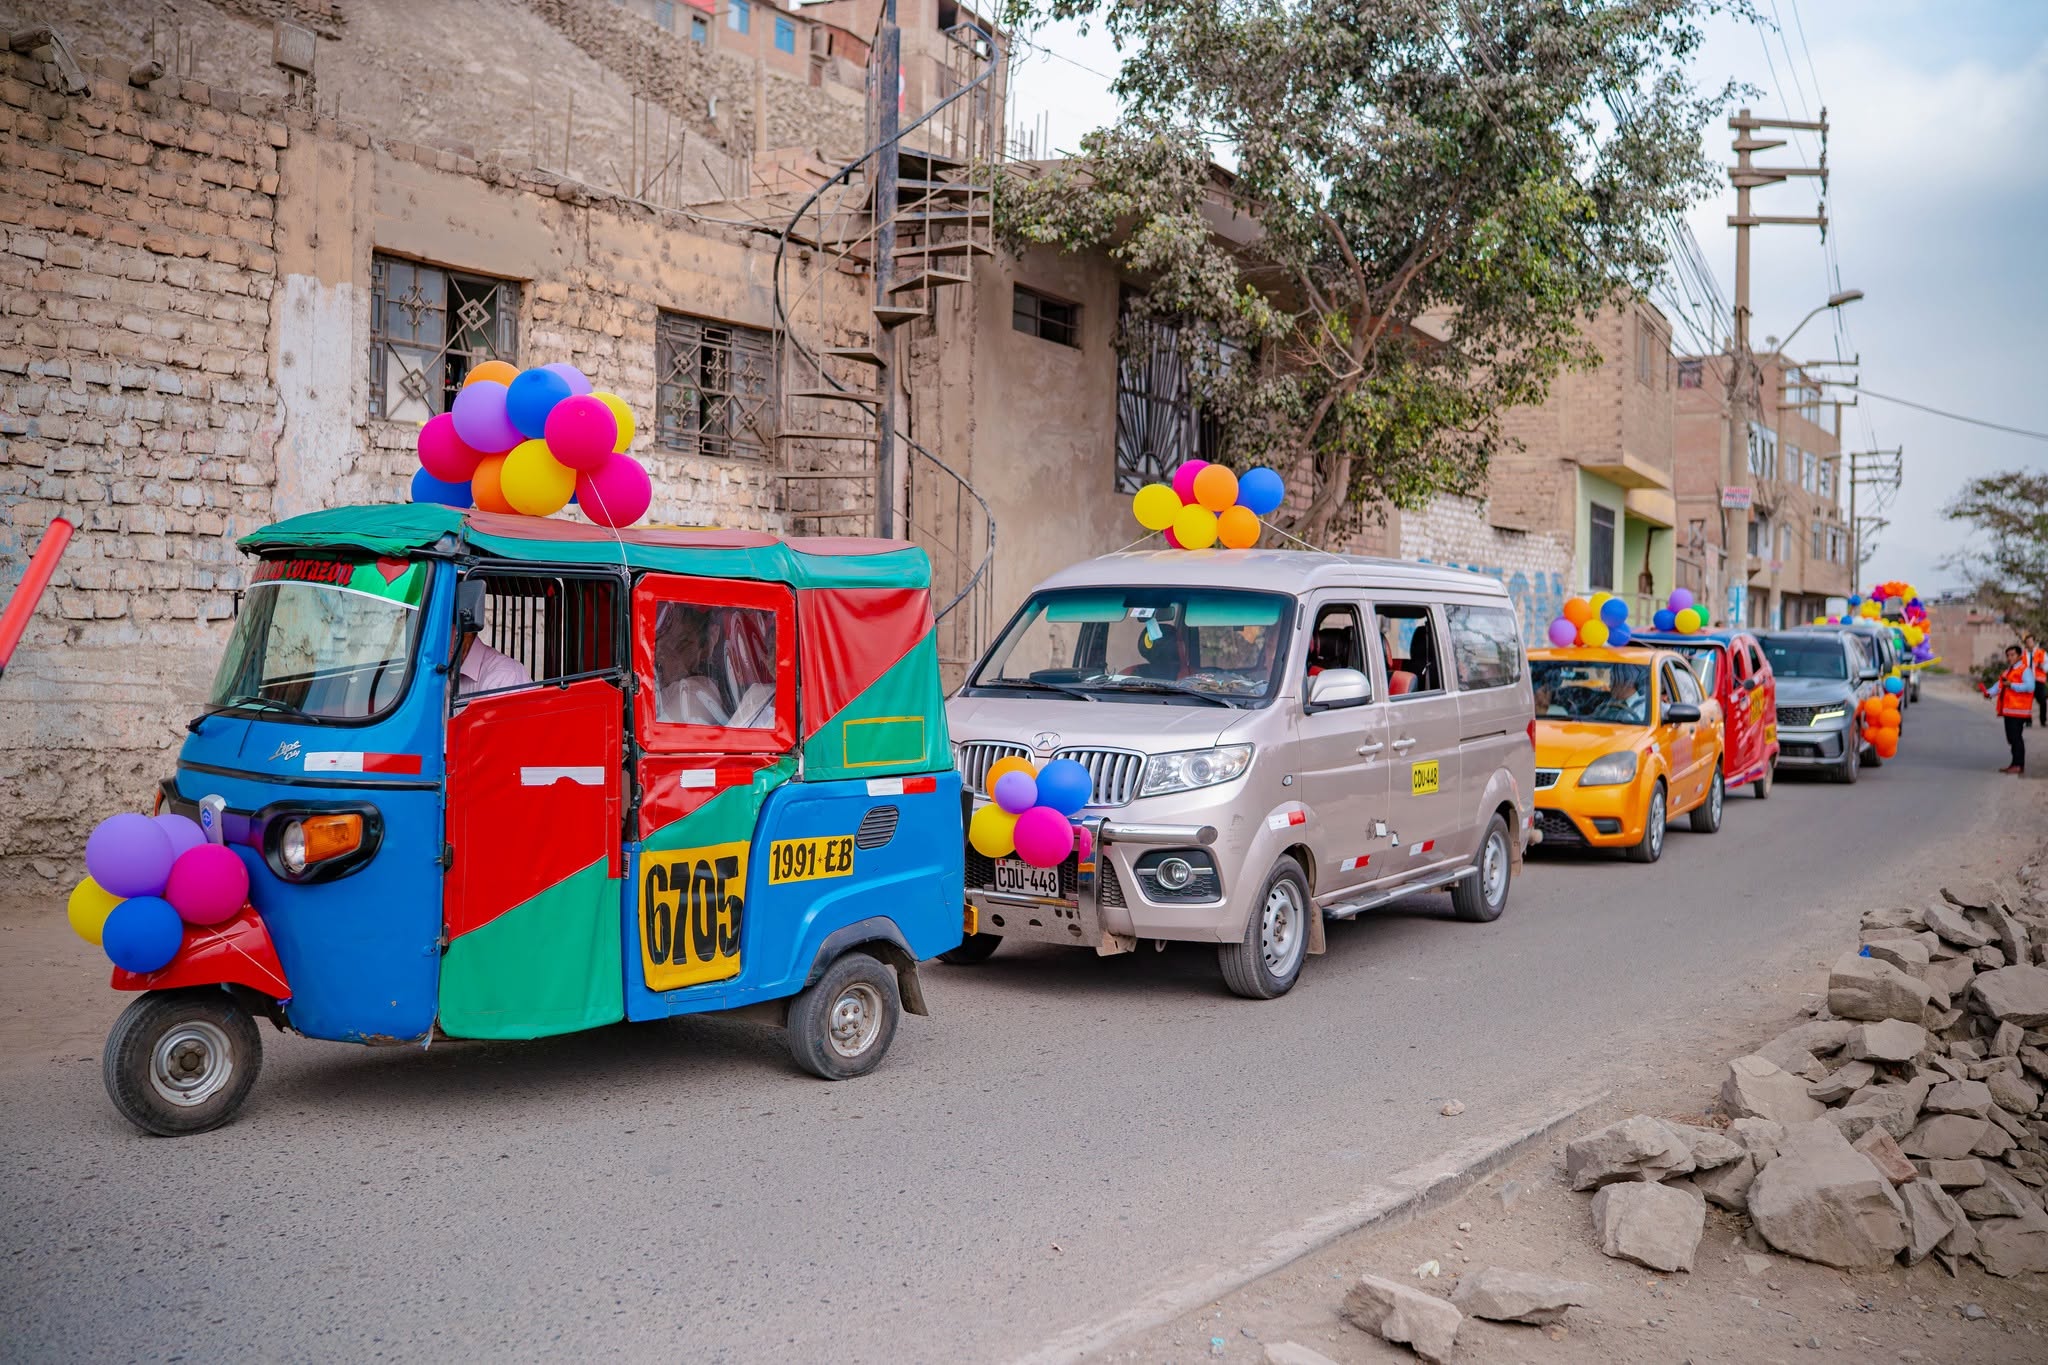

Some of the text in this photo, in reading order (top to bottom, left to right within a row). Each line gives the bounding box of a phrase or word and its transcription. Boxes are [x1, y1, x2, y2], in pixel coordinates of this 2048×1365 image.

[1413, 767, 1438, 789] CDU-448
[997, 866, 1057, 893] CDU-448
[645, 855, 744, 966] 6705
